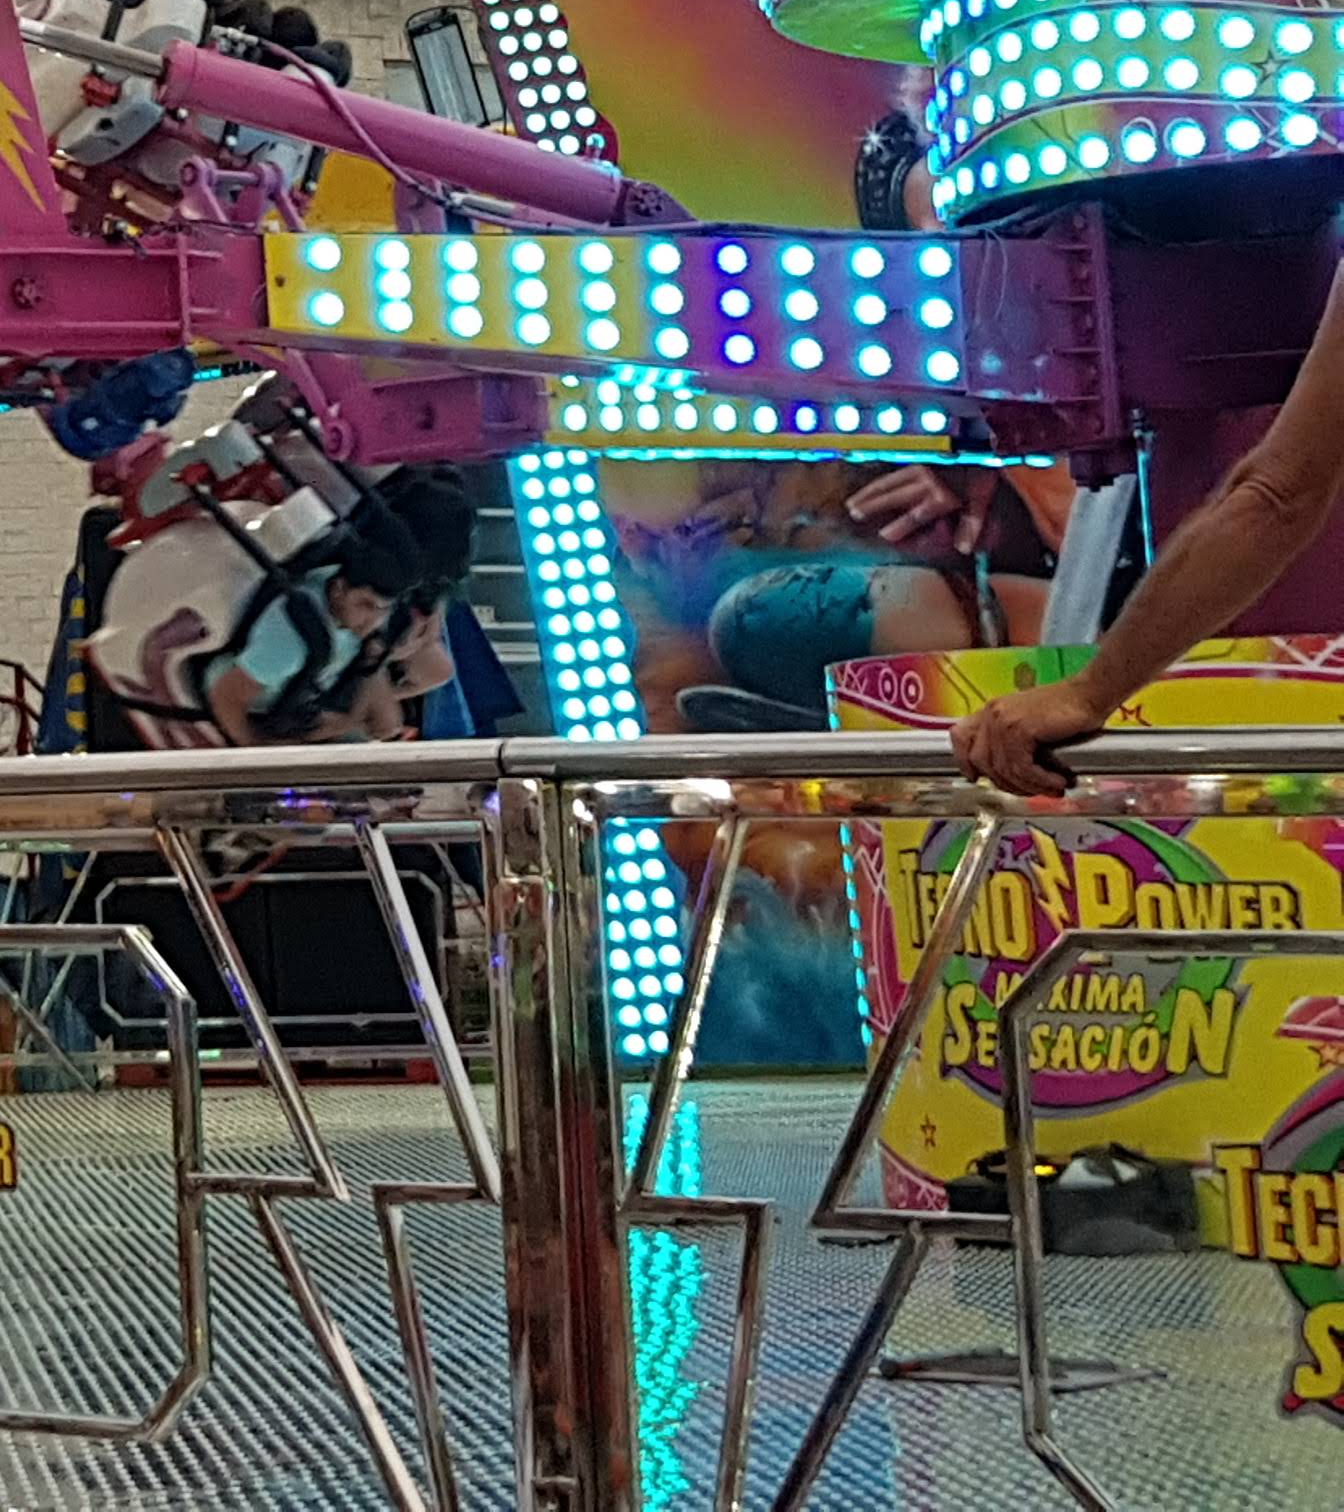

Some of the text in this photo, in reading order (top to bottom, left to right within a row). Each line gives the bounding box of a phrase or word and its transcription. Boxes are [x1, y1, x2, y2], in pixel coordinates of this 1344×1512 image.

[899, 849, 1303, 966] TENO POWER
[944, 982, 1236, 1076] SESACIÓN
[995, 971, 1147, 1014] MXIMA
[1213, 1144, 1344, 1268] TEC
